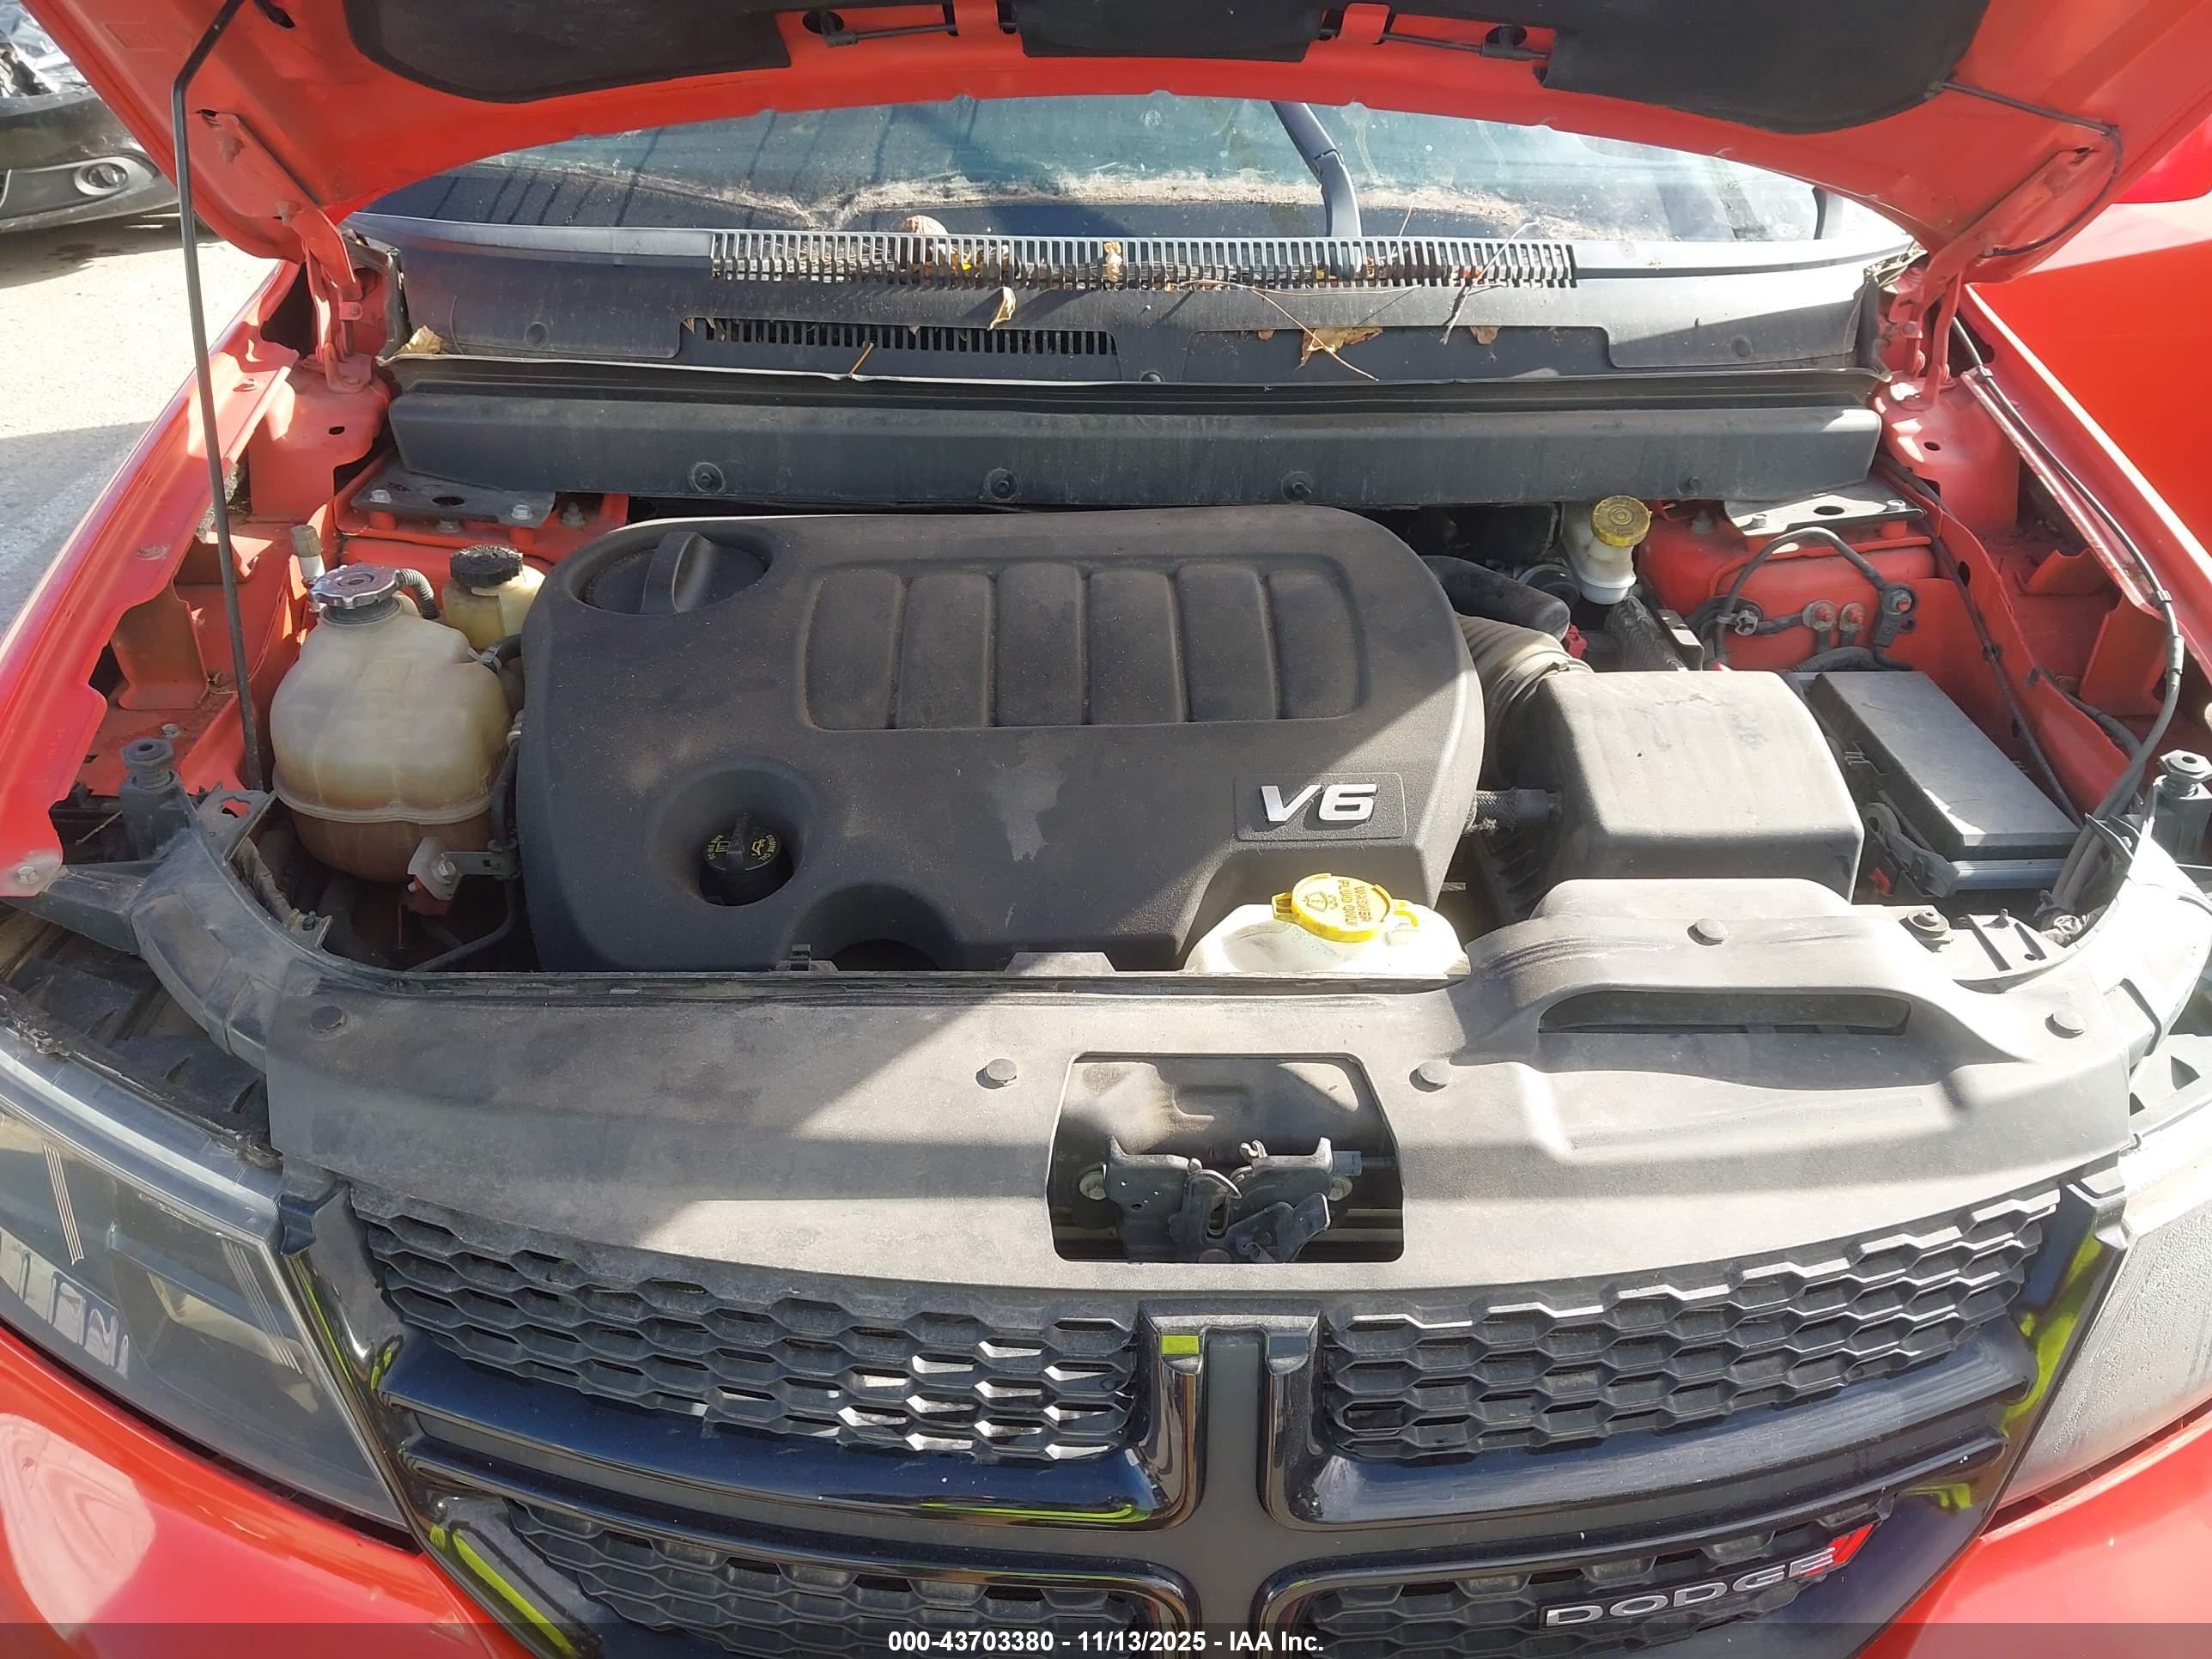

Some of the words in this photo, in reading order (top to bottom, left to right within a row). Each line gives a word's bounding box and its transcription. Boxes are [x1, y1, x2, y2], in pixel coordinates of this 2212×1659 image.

[1260, 783, 1378, 823] V6
[757, 853, 771, 861] OIL
[1338, 879, 1353, 903] FLUID
[1353, 885, 1373, 921] WASHER
[1342, 904, 1358, 927] ONLY
[1545, 1547, 1836, 1628] DODGE
